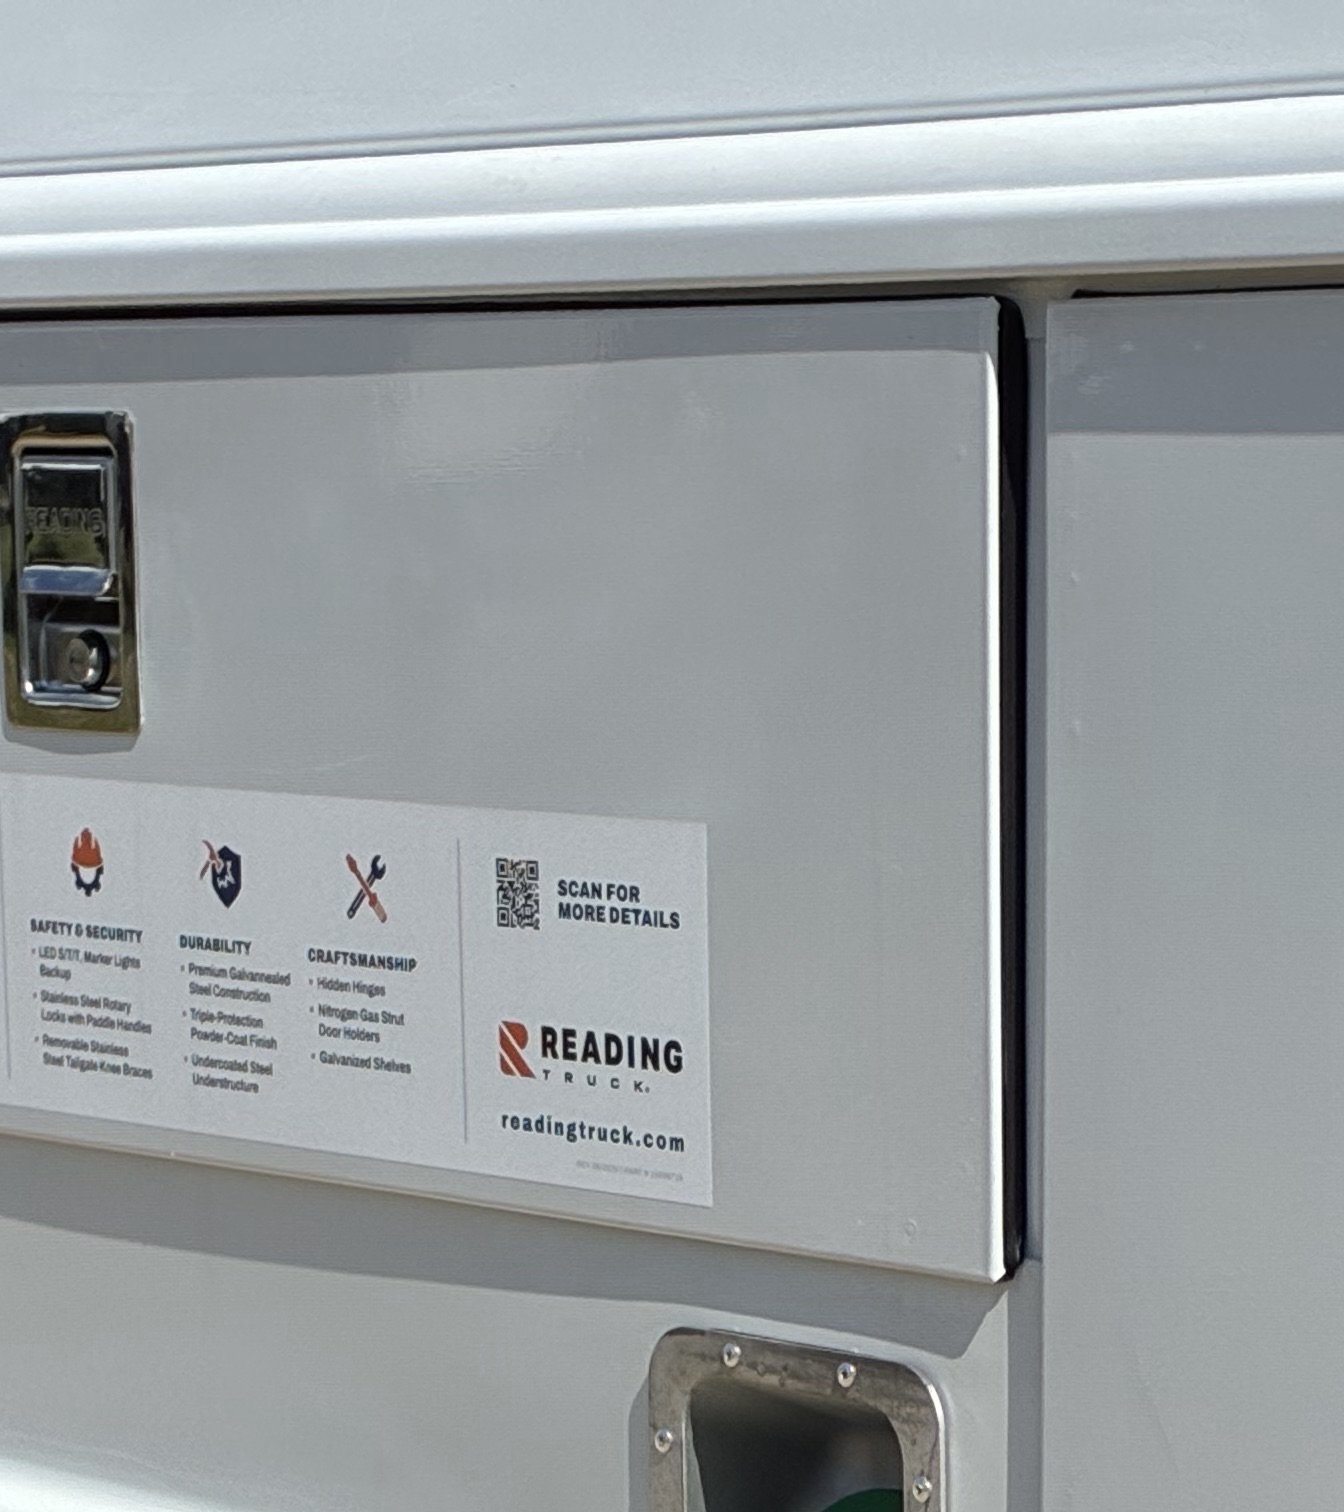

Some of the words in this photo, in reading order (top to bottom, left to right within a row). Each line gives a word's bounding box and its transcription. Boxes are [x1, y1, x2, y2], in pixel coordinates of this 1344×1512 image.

[557, 879, 602, 901] SCAN
[606, 883, 640, 903] FOR
[558, 902, 606, 922] MORE
[610, 908, 680, 930] DETAILS
[30, 918, 72, 936] SAFETY
[85, 925, 143, 943] SECURITY
[179, 934, 252, 955] DURABILITY
[114, 955, 140, 969] Lights
[188, 963, 227, 977] Premium
[308, 948, 417, 972] CRAFTSMANSHIP
[316, 977, 350, 991] Hidden
[352, 980, 385, 997] Hinges
[318, 1003, 358, 1021] Nitrogen
[360, 1008, 379, 1022] Gas
[318, 1023, 340, 1037] Door
[343, 1026, 380, 1042] Holders
[541, 1025, 684, 1074] READING
[319, 1050, 371, 1068] Galvanized
[373, 1059, 411, 1073] Shelves
[501, 1112, 685, 1153] readingtruck.com
